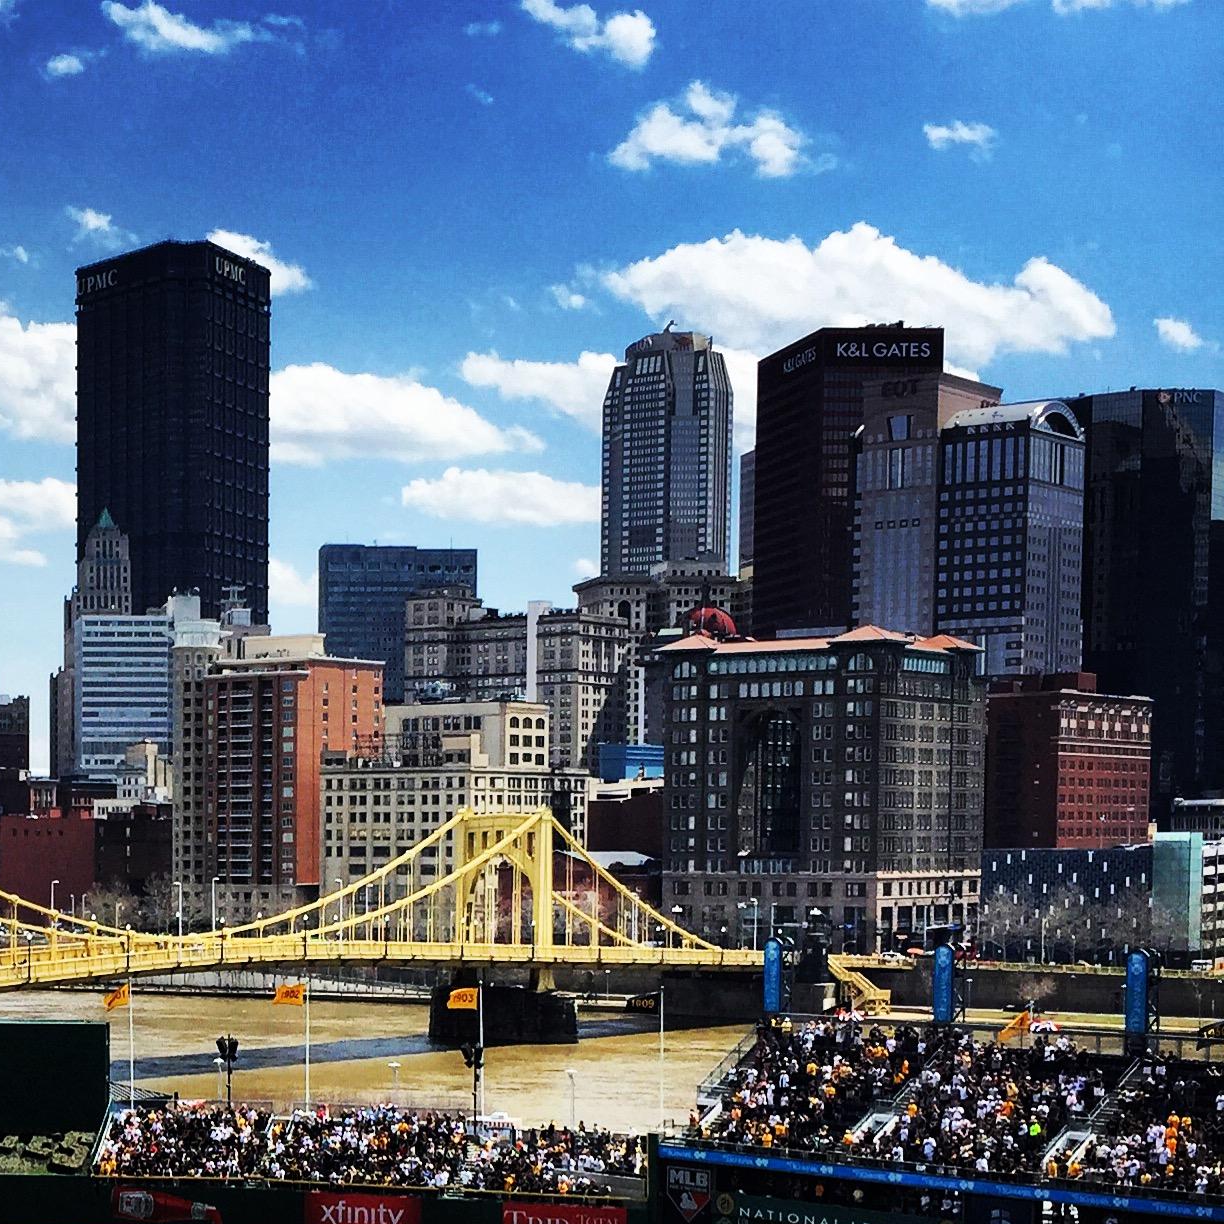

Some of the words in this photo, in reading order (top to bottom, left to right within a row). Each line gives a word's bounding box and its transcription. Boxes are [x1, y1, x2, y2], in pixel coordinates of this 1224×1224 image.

[215, 257, 247, 286] UPMC
[836, 342, 869, 358] K&L
[872, 342, 931, 358] GATES
[1174, 391, 1202, 404] PNC
[669, 1169, 709, 1187] MLB
